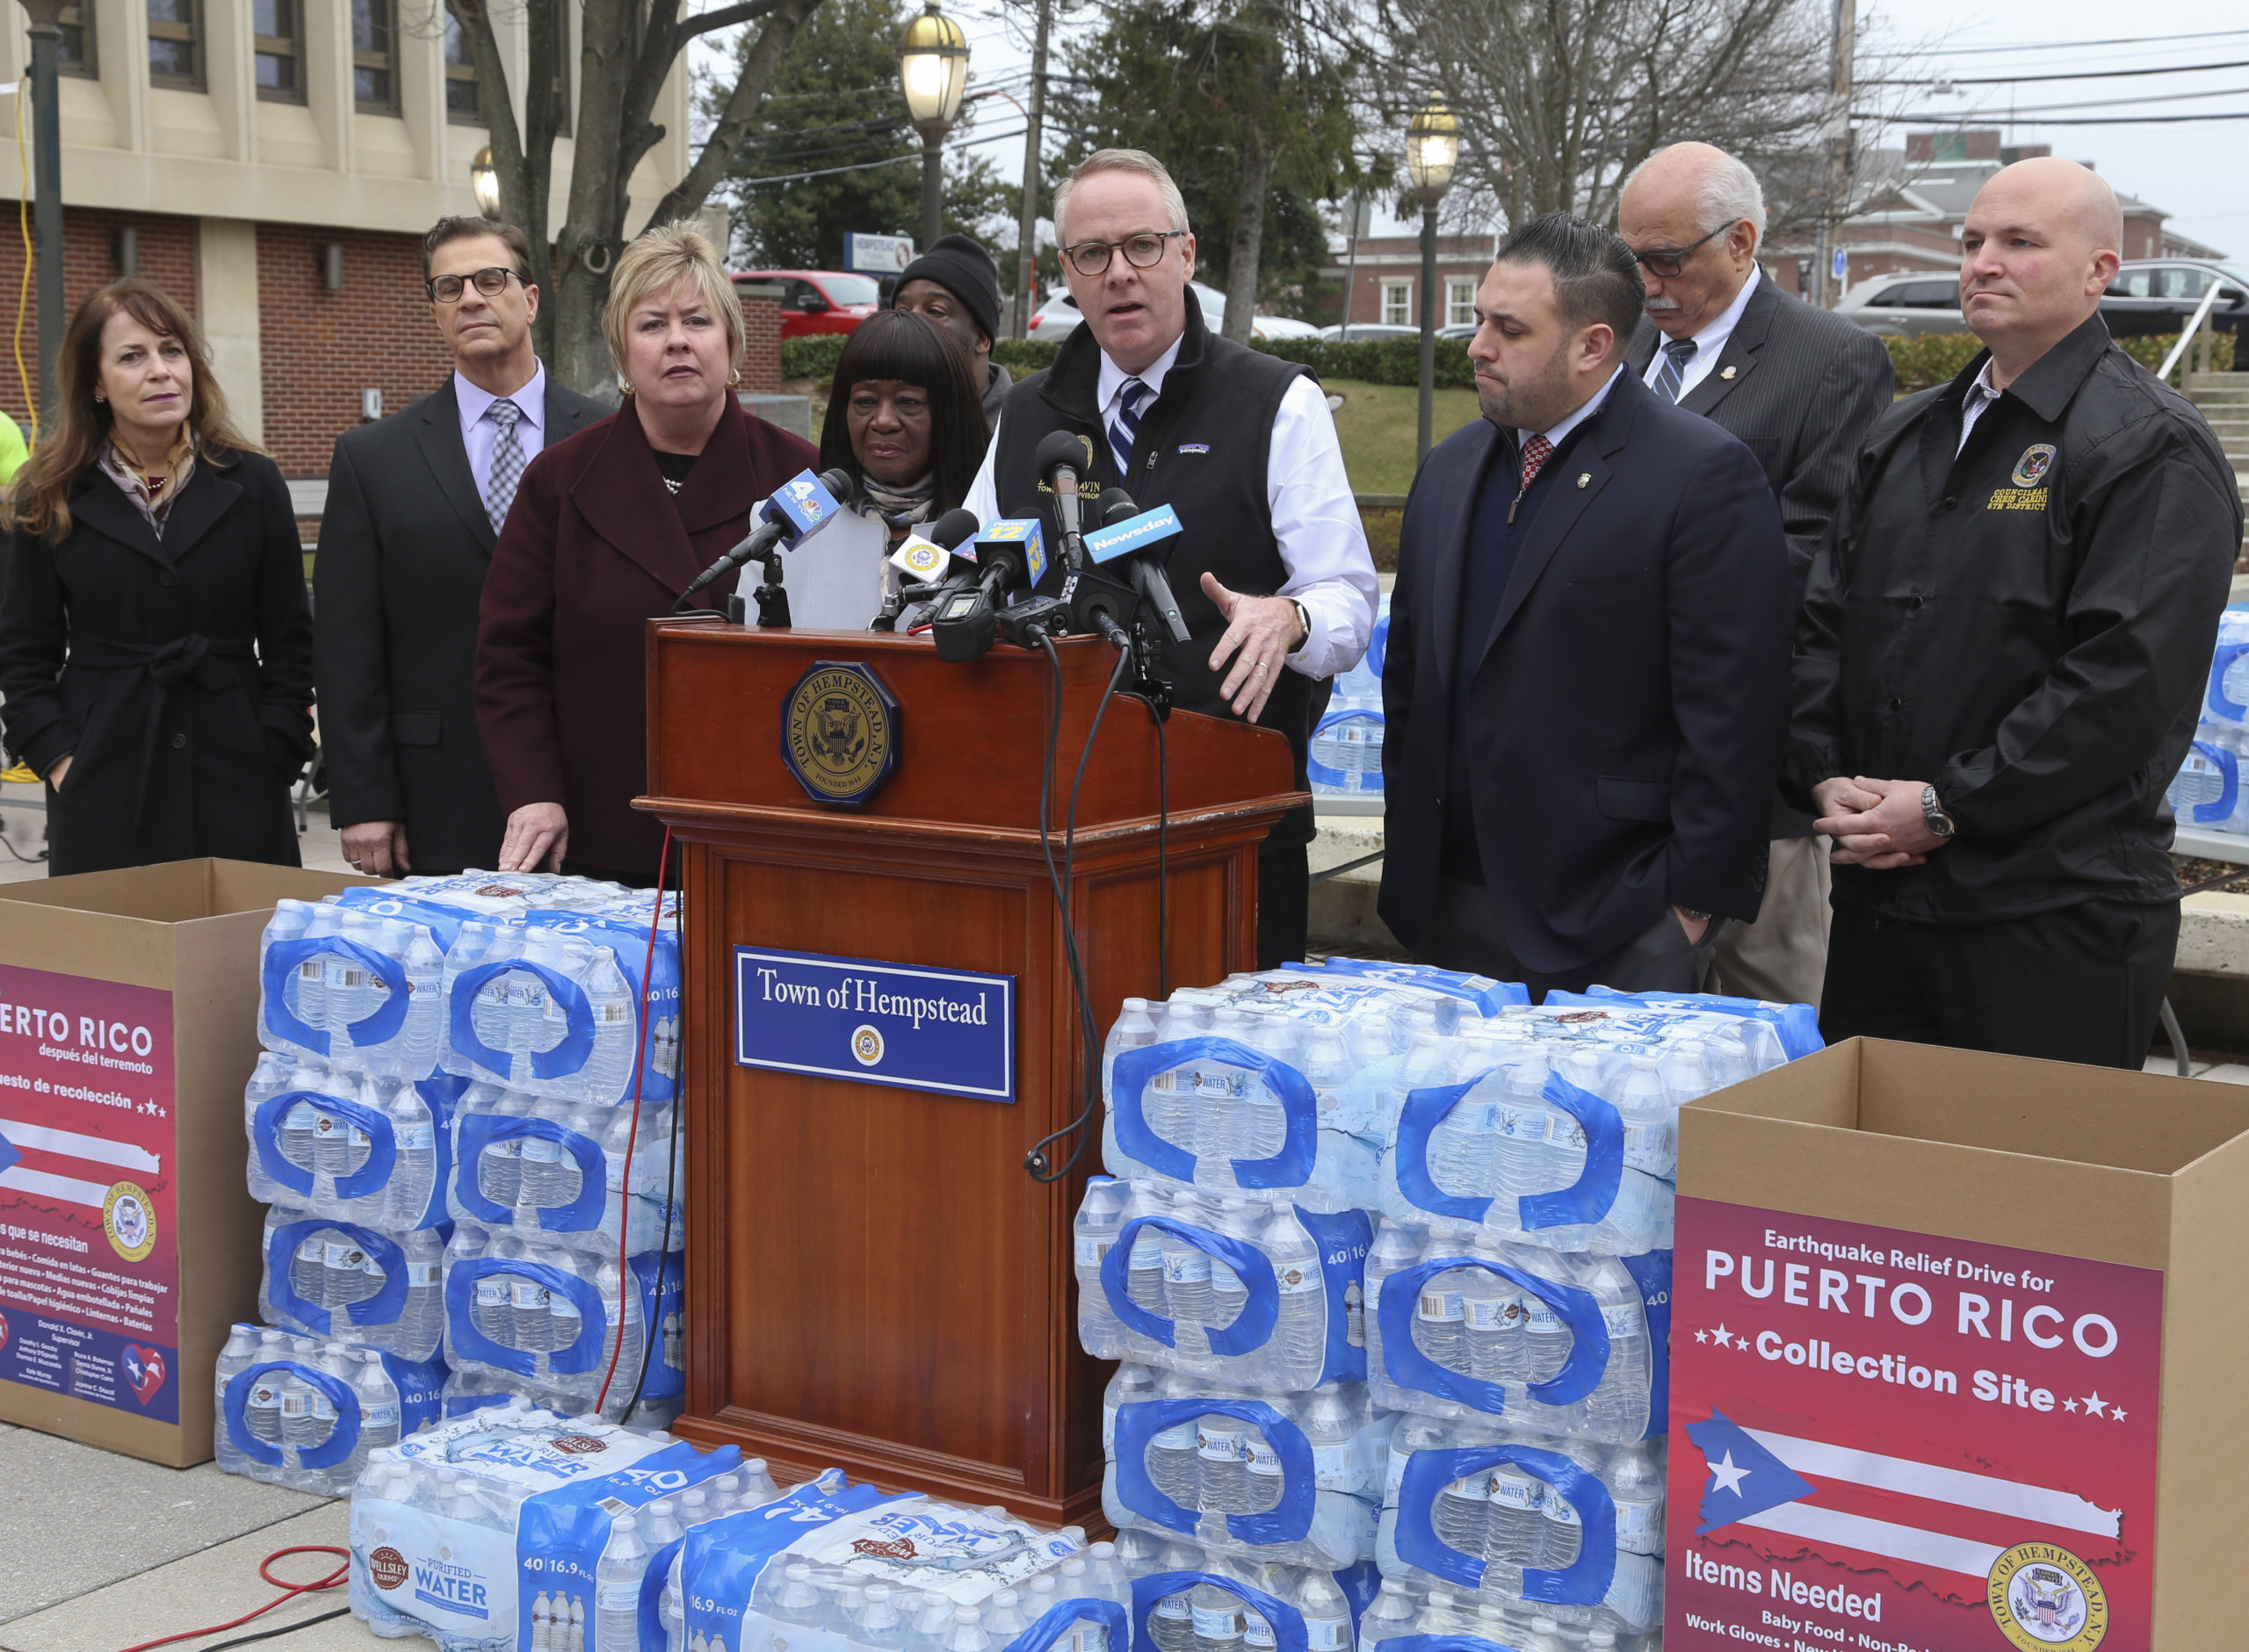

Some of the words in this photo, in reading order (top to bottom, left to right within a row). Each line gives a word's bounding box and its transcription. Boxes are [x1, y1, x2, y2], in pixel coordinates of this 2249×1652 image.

[782, 487, 799, 504] NEW
[790, 481, 815, 501] 4
[1990, 494, 2016, 503] CHRIS
[1994, 487, 2048, 496] COUNCILMAN
[798, 503, 816, 524] YORK
[987, 526, 1023, 539] 12
[1093, 515, 1174, 552] Newsday
[1029, 537, 1040, 578] 12
[797, 691, 812, 711] OF
[792, 718, 811, 769] TOWN
[757, 967, 821, 1006] Town
[827, 977, 852, 1009] of
[855, 979, 987, 1029] Hempstead
[80, 1016, 153, 1057] RICO
[39, 1042, 80, 1062] después
[82, 1050, 98, 1065] del
[100, 1055, 153, 1075] terremoto
[33, 1078, 50, 1094] de
[54, 1083, 132, 1109] recolección
[1203, 1077, 1226, 1089] WATER
[8, 1225, 26, 1241] que
[28, 1230, 40, 1243] se
[41, 1231, 89, 1253] necesitan
[1328, 1253, 1347, 1265] 40
[1765, 1230, 1884, 1264] Earthquake
[1890, 1249, 1951, 1276] Relief
[1956, 1260, 2015, 1287] Drive
[2021, 1270, 2055, 1293] for
[6, 1246, 27, 1261] bebés
[32, 1253, 58, 1268] Comida
[59, 1260, 69, 1270] en
[69, 1261, 87, 1274] latas
[90, 1267, 120, 1283] Guantes
[121, 1276, 137, 1289] para
[138, 1280, 169, 1295] trabajar
[18, 1266, 40, 1278] nueva
[46, 1270, 70, 1284] Medias
[71, 1278, 97, 1291] nuevas
[101, 1283, 127, 1299] Cobijas
[128, 1289, 155, 1305] limpias
[3, 1275, 18, 1288] para
[19, 1279, 52, 1294] mascotas
[56, 1287, 75, 1300] Agua
[76, 1292, 120, 1310] embotellada
[125, 1302, 154, 1318] Pañales
[1647, 1291, 1667, 1306] 40
[1705, 1250, 1933, 1326] PUERTO
[1958, 1291, 2118, 1358] RICO
[6, 1288, 48, 1307] toalla/Papel
[48, 1296, 81, 1315] higiénico
[85, 1307, 119, 1324] Linternas
[123, 1316, 153, 1332] Baterías
[1531, 1311, 1555, 1324] WATER
[1756, 1331, 1956, 1395] Collection
[1971, 1370, 2056, 1412] Site
[405, 1393, 422, 1404] 40
[1207, 1440, 1230, 1452] WATER
[1255, 1454, 1279, 1466] WATER
[623, 1468, 689, 1490] 40
[1500, 1484, 1524, 1499] WATER
[371, 1558, 408, 1577] WELLSLEY
[428, 1558, 471, 1579] PURIFIED
[524, 1557, 544, 1572] 40
[550, 1558, 578, 1575] 16.9
[1998, 1555, 2015, 1575] OF
[416, 1566, 487, 1606] WATER
[1685, 1549, 1762, 1594] Items
[1770, 1568, 1882, 1622] Needed
[1161, 1598, 1183, 1610] WATER
[1992, 1579, 2011, 1628] TOWN
[1249, 1624, 1270, 1637] WATER
[1687, 1613, 1725, 1634] Work
[1729, 1624, 1781, 1648] Gloves
[1761, 1610, 1801, 1634] Baby
[1804, 1620, 1845, 1641] Food
